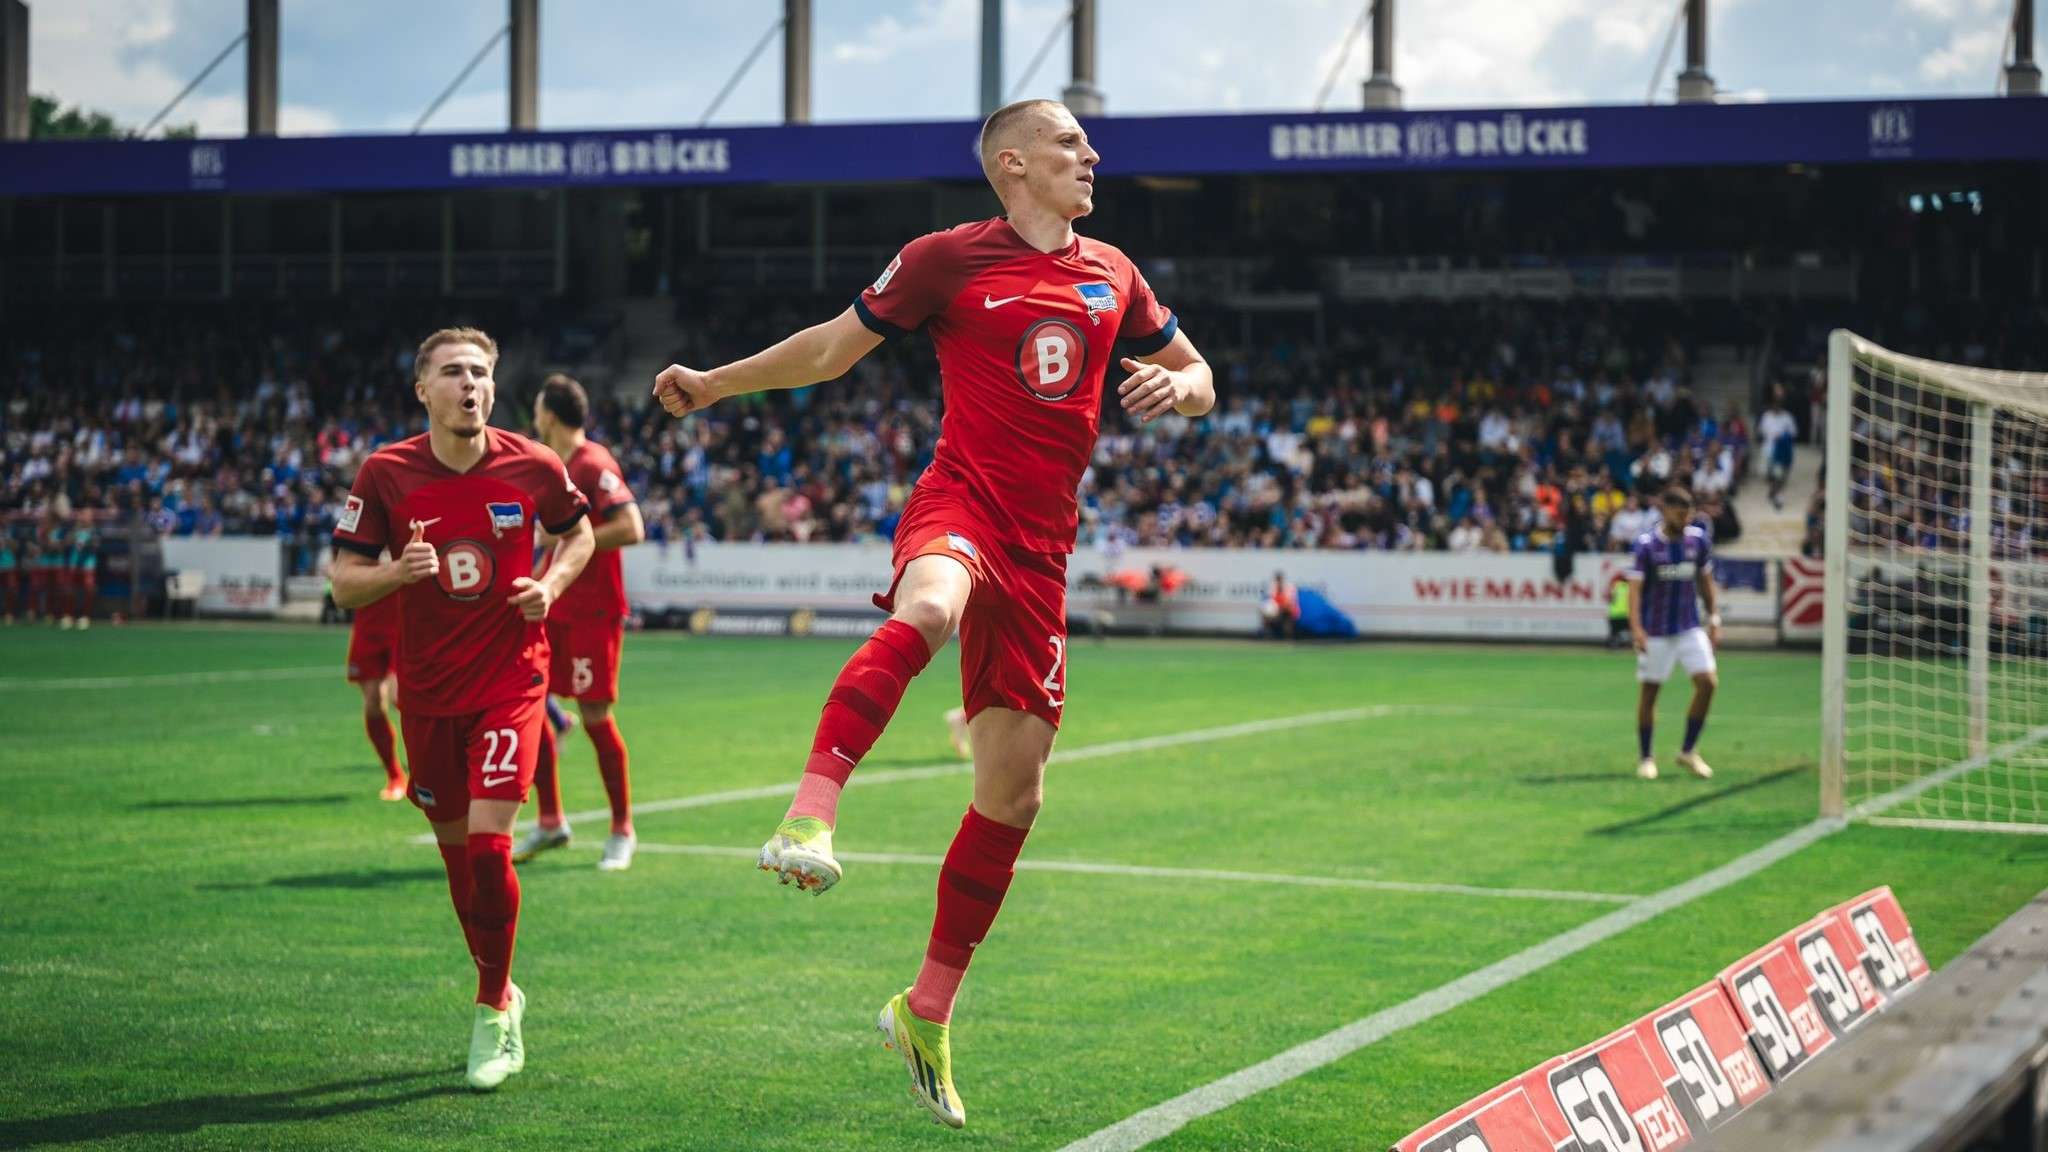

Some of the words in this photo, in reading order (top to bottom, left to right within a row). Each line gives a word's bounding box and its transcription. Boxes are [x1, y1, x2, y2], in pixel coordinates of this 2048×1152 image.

[450, 142, 565, 178] BREMER
[612, 134, 729, 175] BRÜCKE
[1270, 122, 1400, 160] BREMER
[1454, 113, 1587, 157] BRÜCKE
[1036, 336, 1069, 385] B
[448, 551, 481, 590] B
[1413, 577, 1593, 600] WIEMANN
[482, 728, 518, 773] 22
[1789, 1001, 1826, 1045] TECH
[1720, 1049, 1764, 1097] TECH
[1632, 1094, 1686, 1152] TECH
